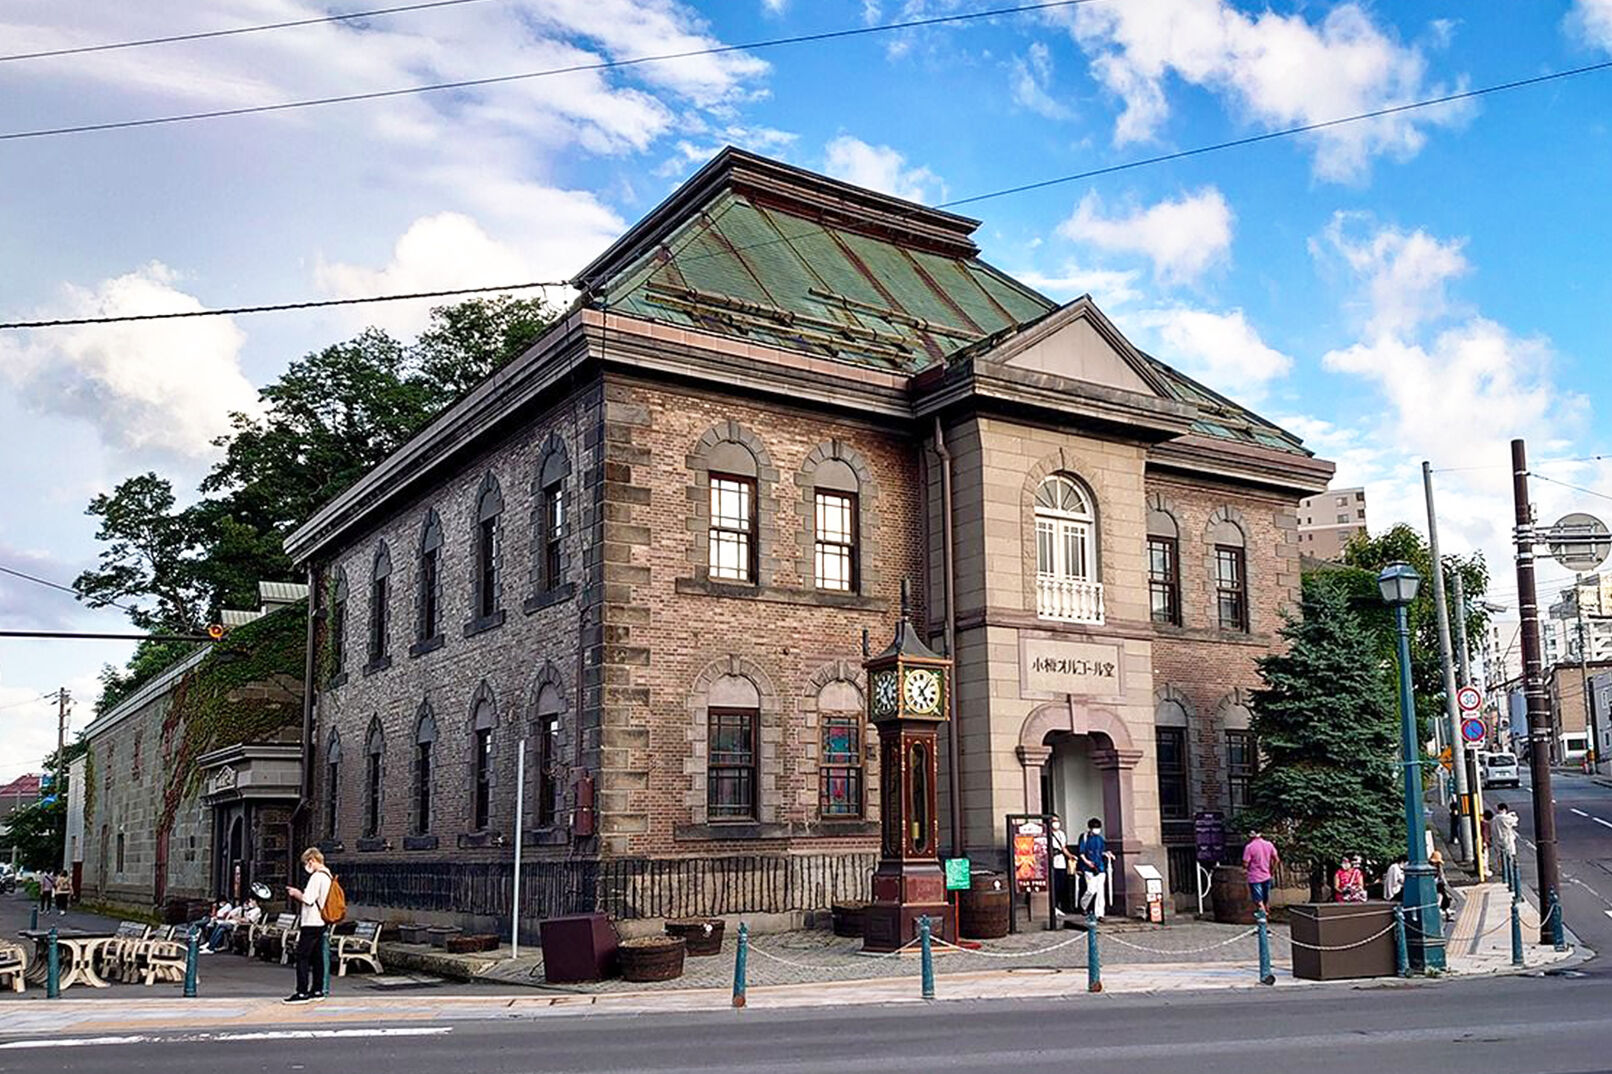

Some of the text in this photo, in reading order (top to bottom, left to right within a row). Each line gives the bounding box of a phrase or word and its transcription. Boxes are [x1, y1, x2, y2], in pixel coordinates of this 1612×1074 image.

[1032, 657, 1115, 677] 小樽オルゴール堂
[1463, 693, 1477, 705] 30
